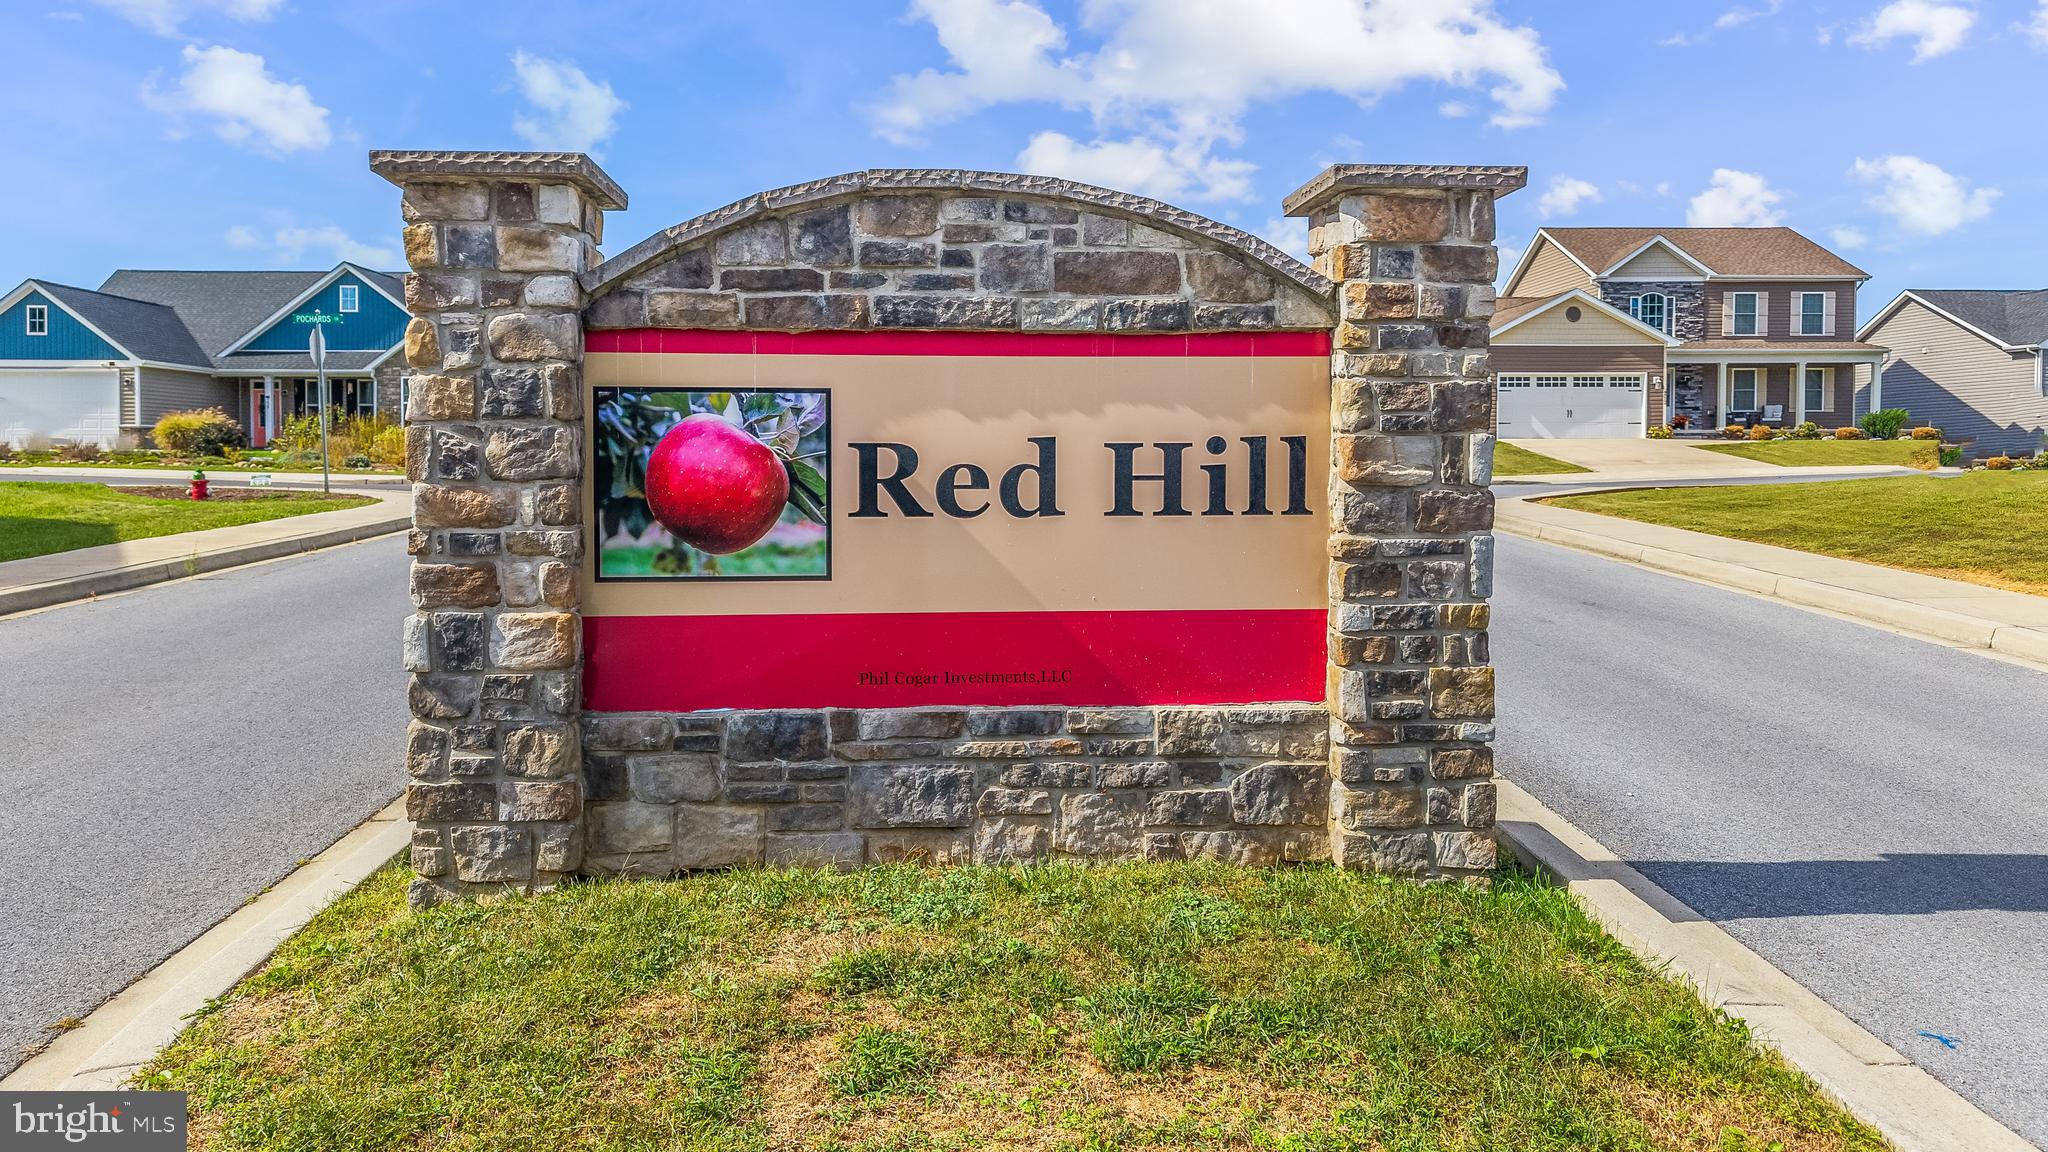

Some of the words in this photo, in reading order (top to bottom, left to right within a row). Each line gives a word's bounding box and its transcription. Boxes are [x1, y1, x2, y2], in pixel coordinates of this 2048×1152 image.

[847, 436, 1066, 518] Red
[1103, 435, 1314, 517] Hill
[859, 672, 889, 685] Phil
[894, 672, 938, 687] Cogar
